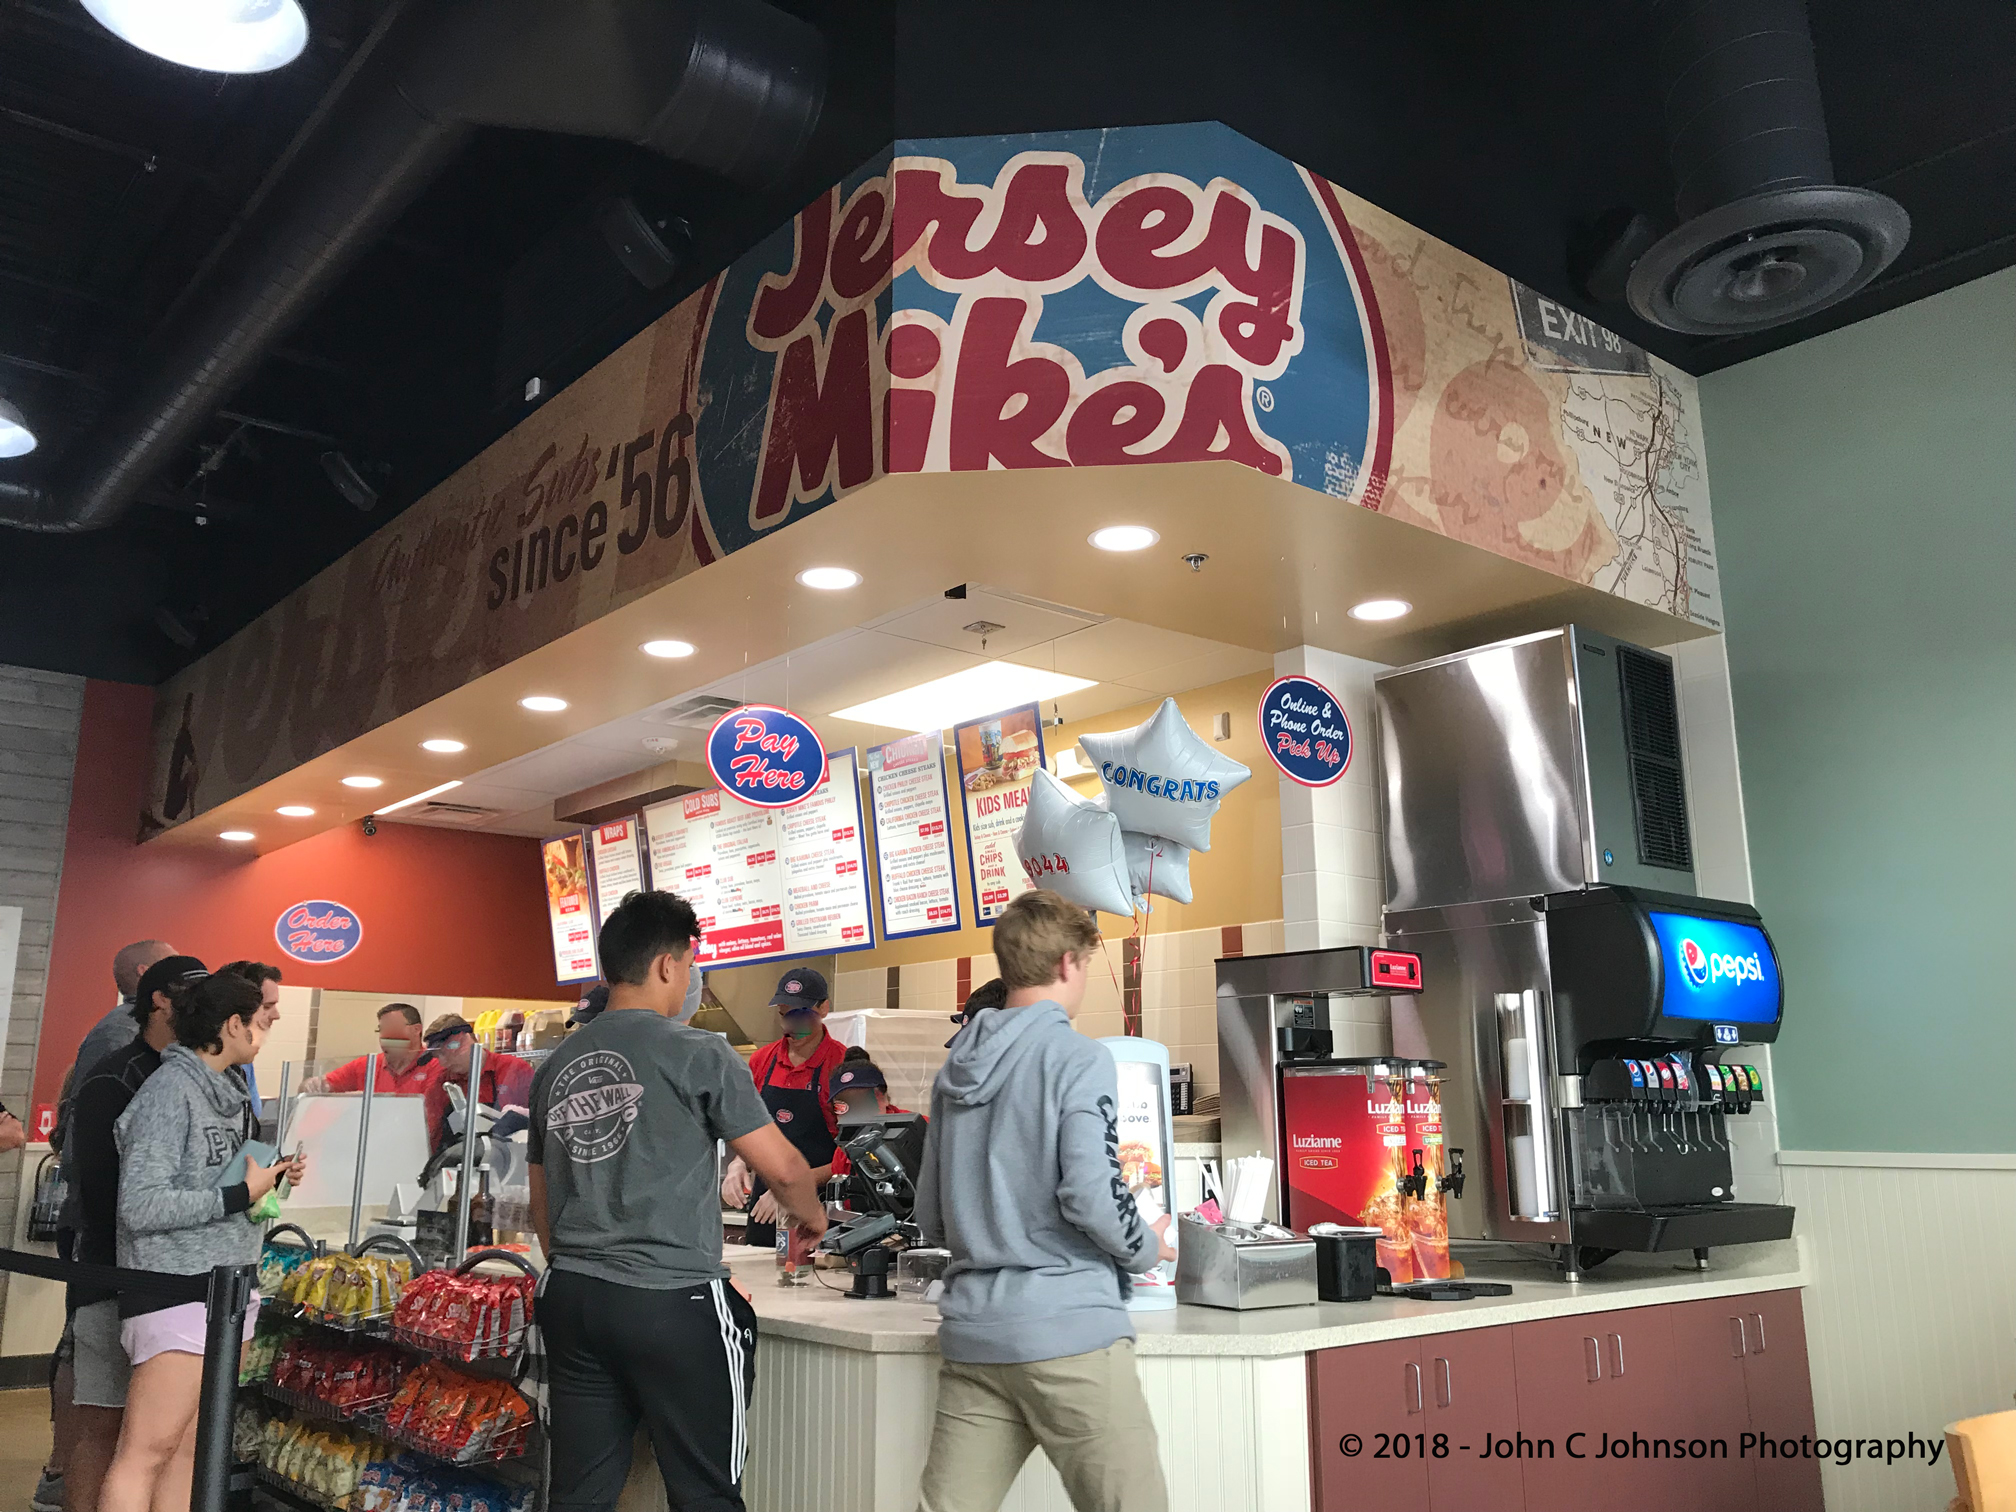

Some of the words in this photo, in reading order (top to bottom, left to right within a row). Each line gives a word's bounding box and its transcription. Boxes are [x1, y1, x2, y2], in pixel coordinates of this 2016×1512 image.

[750, 158, 1299, 369] Jersey
[1538, 298, 1597, 348] EXIT
[1601, 326, 1621, 354] 98
[755, 296, 1285, 520] Mike's
[1593, 425, 1627, 450] NEW
[517, 433, 601, 527] Subs
[487, 501, 608, 611] since
[605, 412, 694, 555] '56
[1280, 692, 1319, 716] Online
[1322, 702, 1332, 719] &
[734, 717, 799, 762] Pay
[1270, 709, 1308, 734] Phone
[1311, 719, 1345, 742] Order
[1276, 733, 1311, 758] Pick
[1315, 741, 1341, 768] Up
[730, 754, 806, 790] Here
[877, 772, 897, 782] CHICKEN
[898, 766, 917, 777] CHEESE
[917, 761, 936, 771] STEAKS
[1102, 761, 1221, 803] CONGRATS
[684, 796, 700, 814] COLD
[700, 790, 718, 809] SUBS
[975, 793, 1001, 817] KIDS
[603, 821, 623, 841] WRAPS
[984, 841, 996, 850] add
[979, 849, 1003, 866] CHIPS
[980, 863, 1006, 881] DRINK
[287, 907, 352, 930] Order
[288, 930, 345, 953] Here
[1710, 952, 1763, 986] pepsi
[557, 1068, 576, 1087] THE
[580, 1056, 624, 1072] ORIGINAL
[547, 1105, 568, 1122] OFF
[567, 1092, 602, 1118] THE
[600, 1087, 632, 1108] WALL
[1293, 1134, 1342, 1149] Luzianne
[1304, 1159, 1319, 1167] ICED
[1320, 1159, 1333, 1167] TEA
